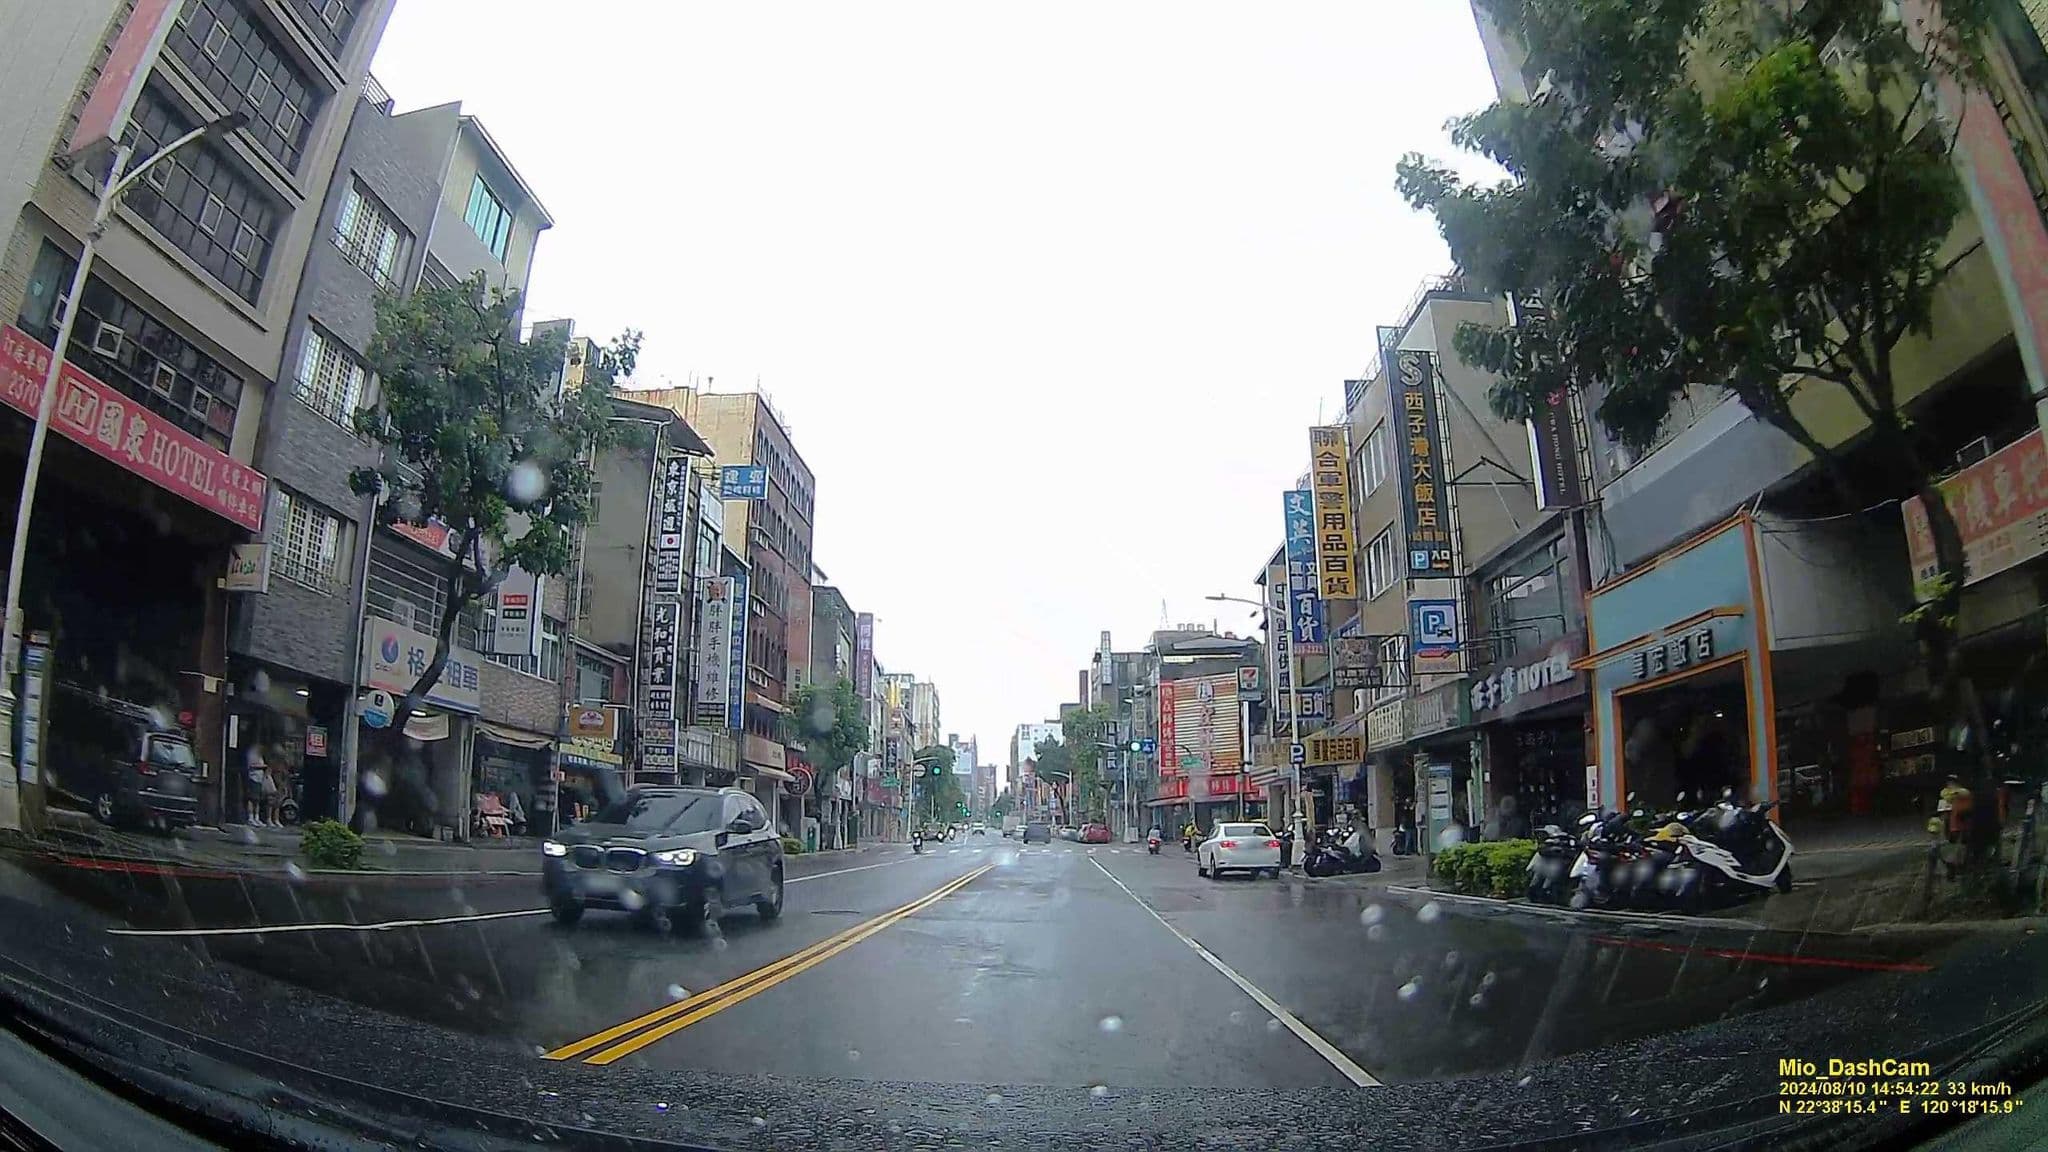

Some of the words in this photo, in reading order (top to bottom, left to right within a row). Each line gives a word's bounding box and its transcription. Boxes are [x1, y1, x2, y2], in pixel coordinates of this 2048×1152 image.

[150, 429, 216, 498] HOTEL
[1403, 391, 1438, 528] 西子灣大飯店
